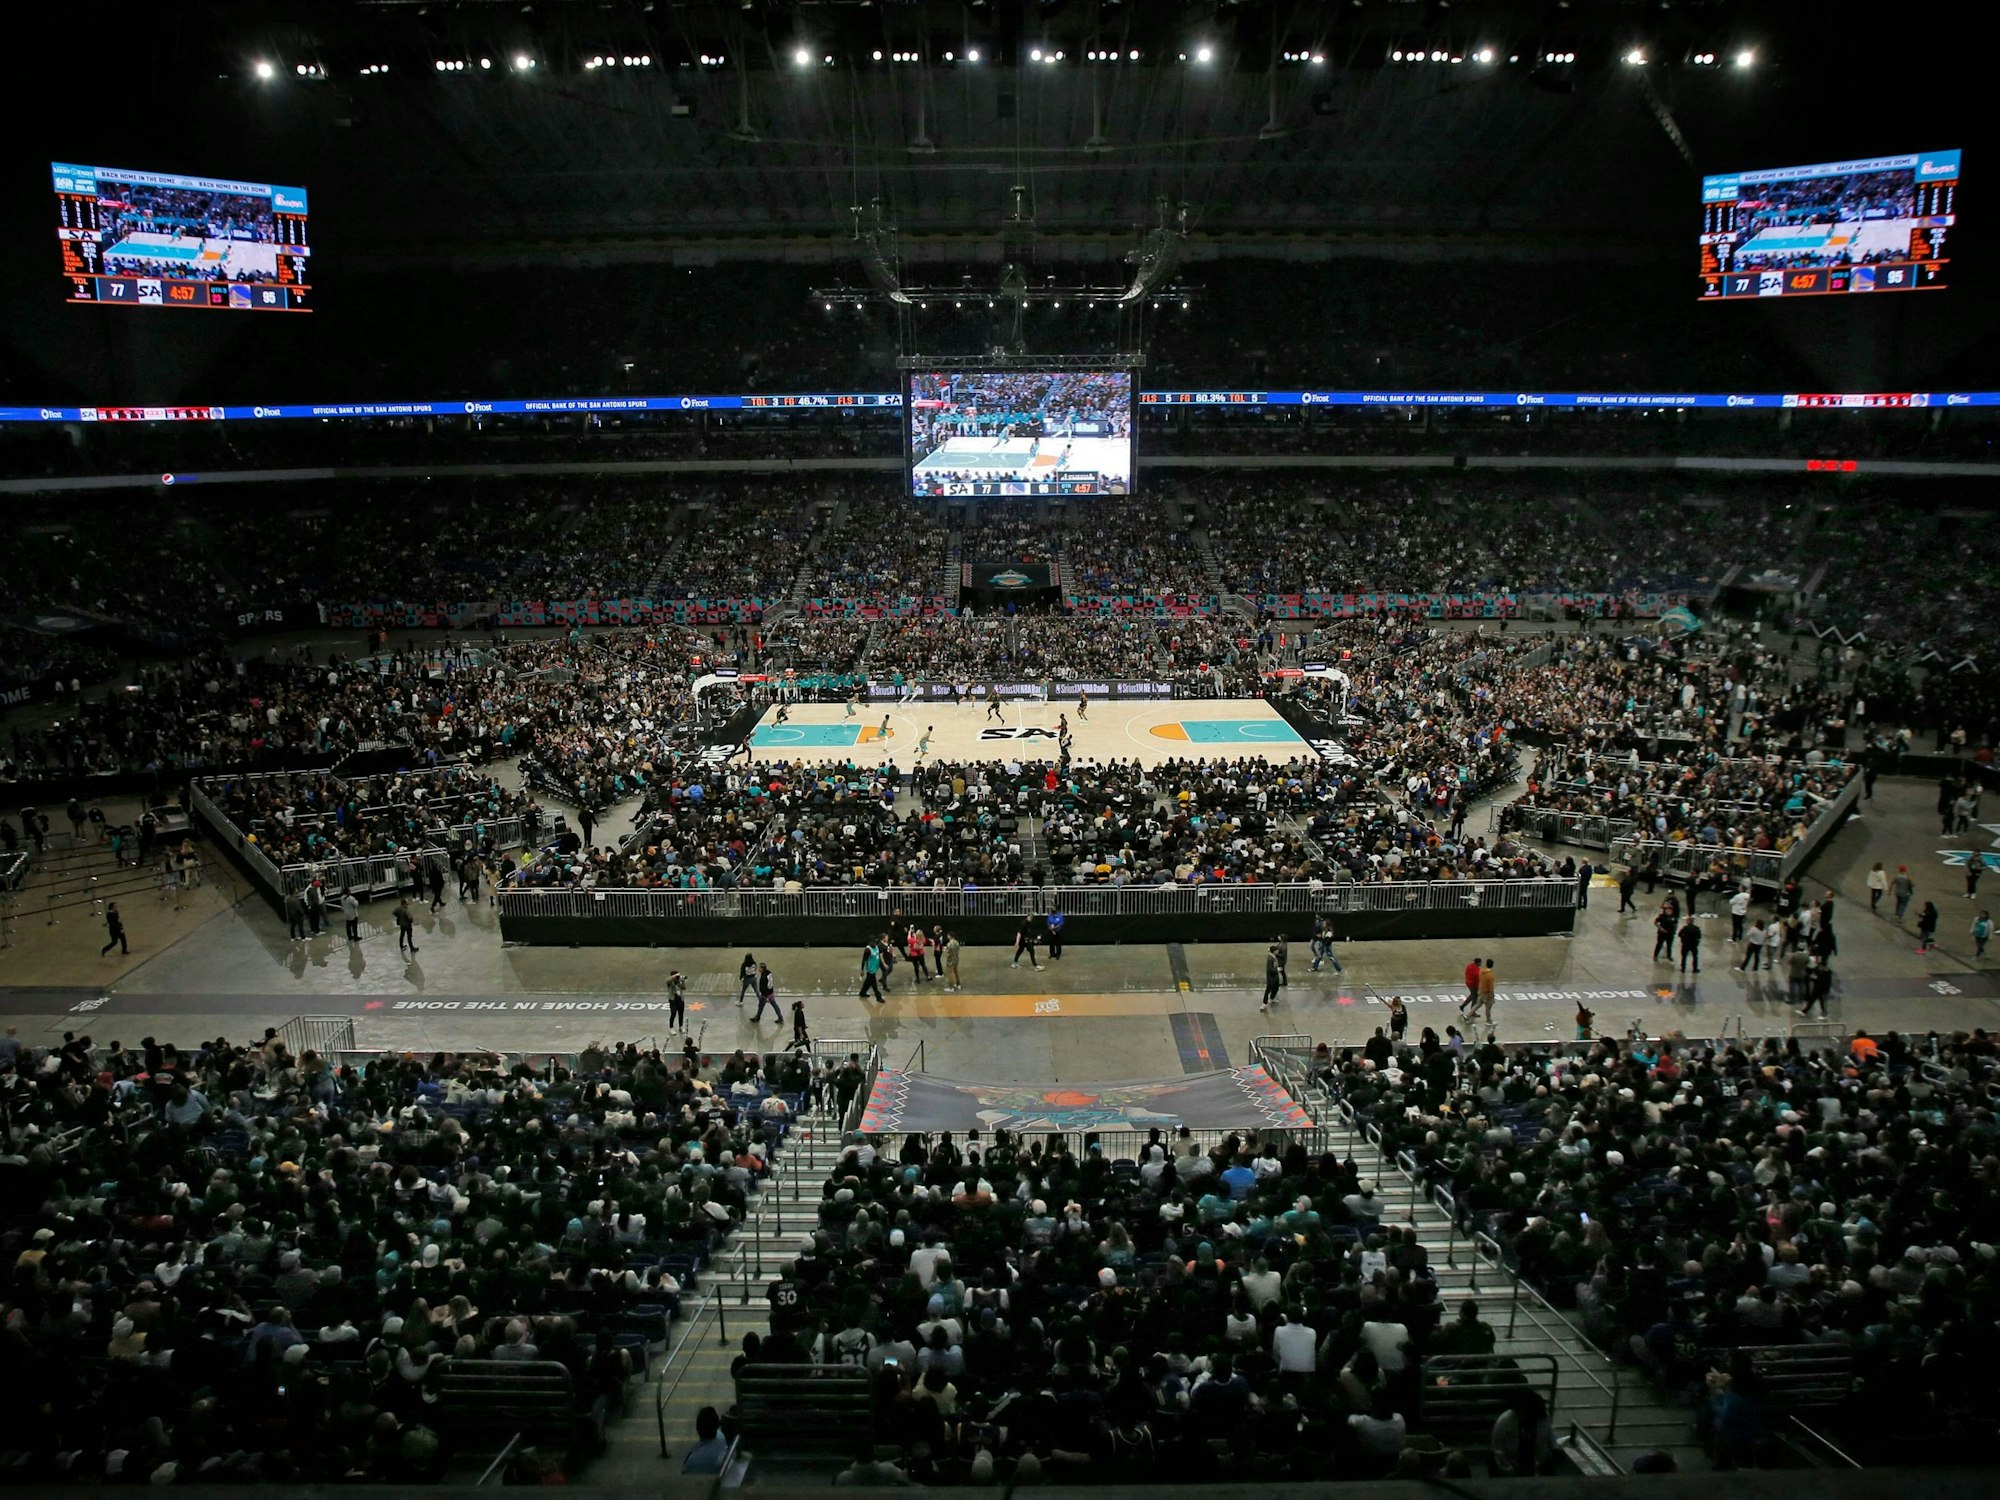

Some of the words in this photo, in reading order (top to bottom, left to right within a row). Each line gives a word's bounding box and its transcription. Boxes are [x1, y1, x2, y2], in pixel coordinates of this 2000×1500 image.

[72, 277, 88, 286] TOL
[1790, 274, 1817, 289] 4:57
[1888, 270, 1903, 284] 95
[1736, 279, 1750, 292] 77
[1760, 277, 1783, 289] SA
[111, 283, 124, 297] 77
[138, 286, 161, 297] SA
[170, 285, 194, 300] 4:57
[262, 291, 276, 303] 95
[885, 396, 900, 404] SA
[1736, 396, 1754, 405] Frost
[264, 408, 281, 416] Frost
[950, 484, 968, 495] SA
[982, 485, 992, 494] 77
[1075, 484, 1091, 492] 4:57
[237, 610, 283, 626] SPRS
[999, 684, 1020, 694] SiriusXM
[1021, 684, 1031, 694] NBA
[1061, 684, 1082, 693] SiriusXM
[1083, 684, 1094, 693] NBA
[1094, 684, 1109, 693] Radio
[1123, 683, 1143, 693] SiriusXM
[981, 728, 1058, 740] SA
[1435, 993, 1466, 1002] HE
[1514, 990, 1581, 1000] HOME
[1586, 988, 1648, 998] BACK
[393, 1001, 460, 1010] DOME
[463, 1002, 507, 1010] THE
[513, 1002, 537, 1010] IN
[541, 1002, 609, 1010] HOME
[613, 1002, 671, 1011] BACK
[1722, 1086, 1738, 1096] 20
[777, 1290, 797, 1306] 30
